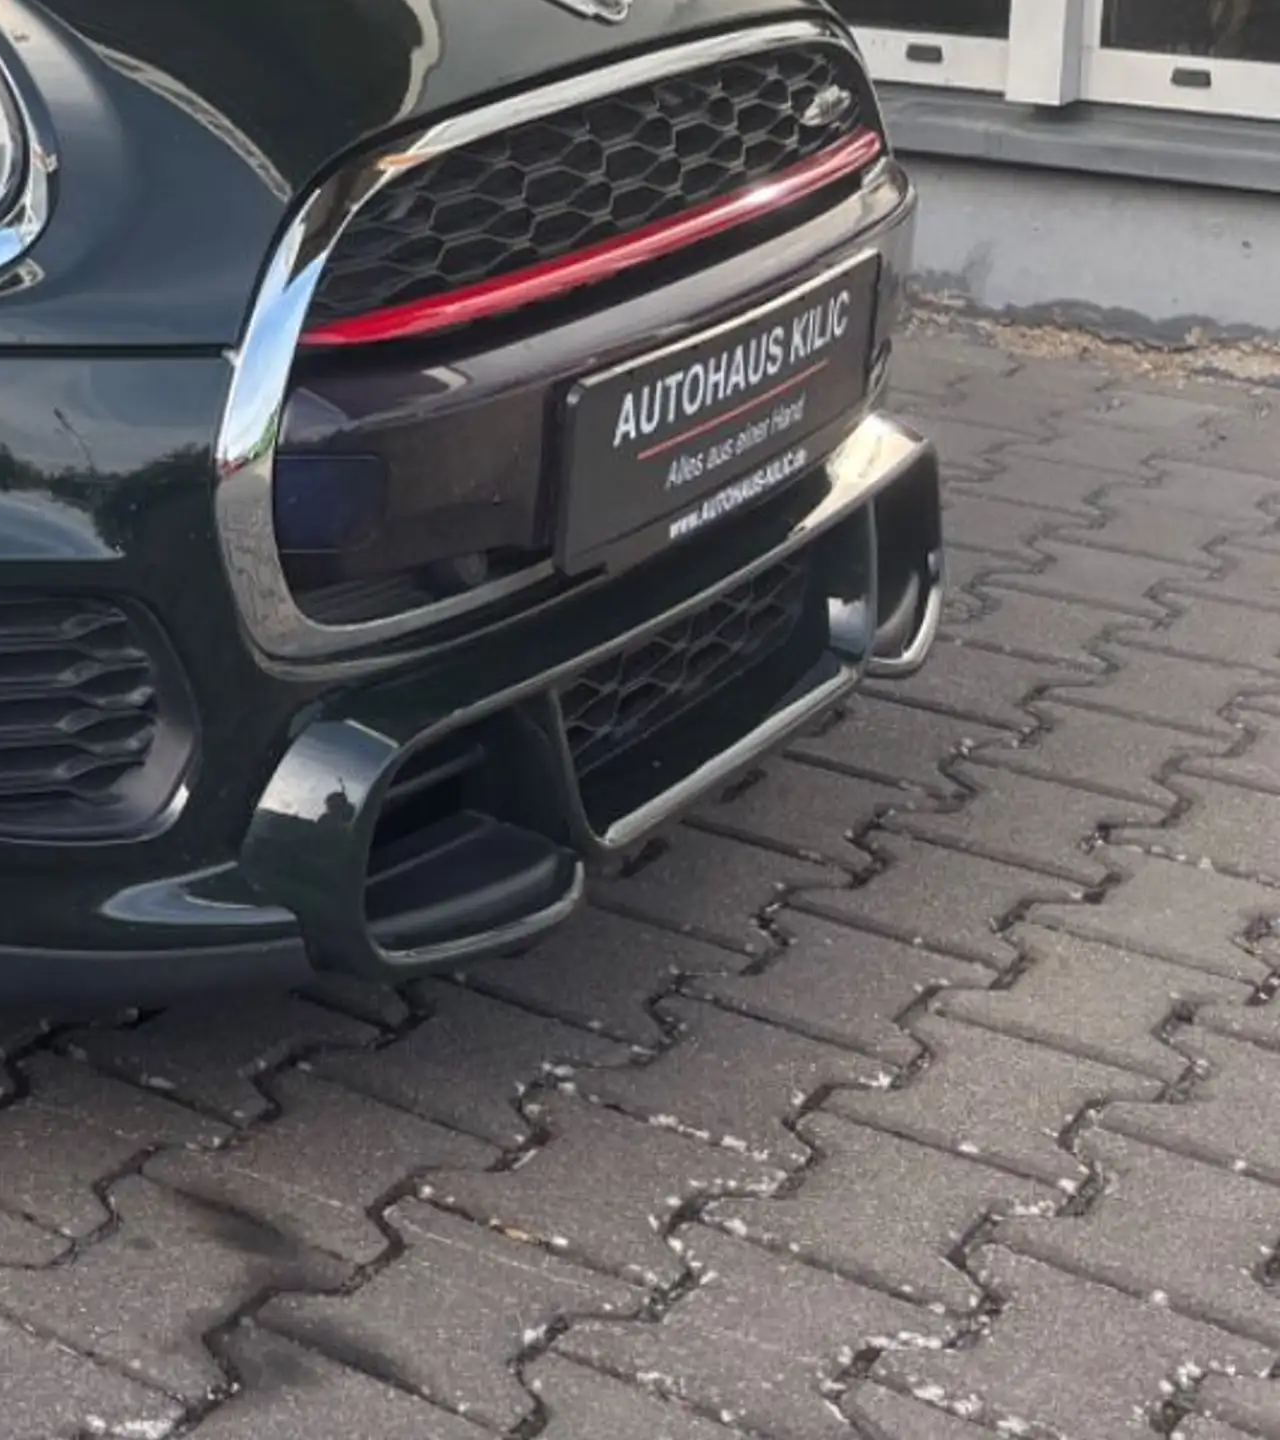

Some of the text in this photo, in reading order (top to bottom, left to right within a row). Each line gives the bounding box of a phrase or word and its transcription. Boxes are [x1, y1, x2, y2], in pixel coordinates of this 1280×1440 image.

[612, 289, 851, 448] AUTOHAUS KILIC
[664, 389, 807, 491] Alles aus einer Hand
